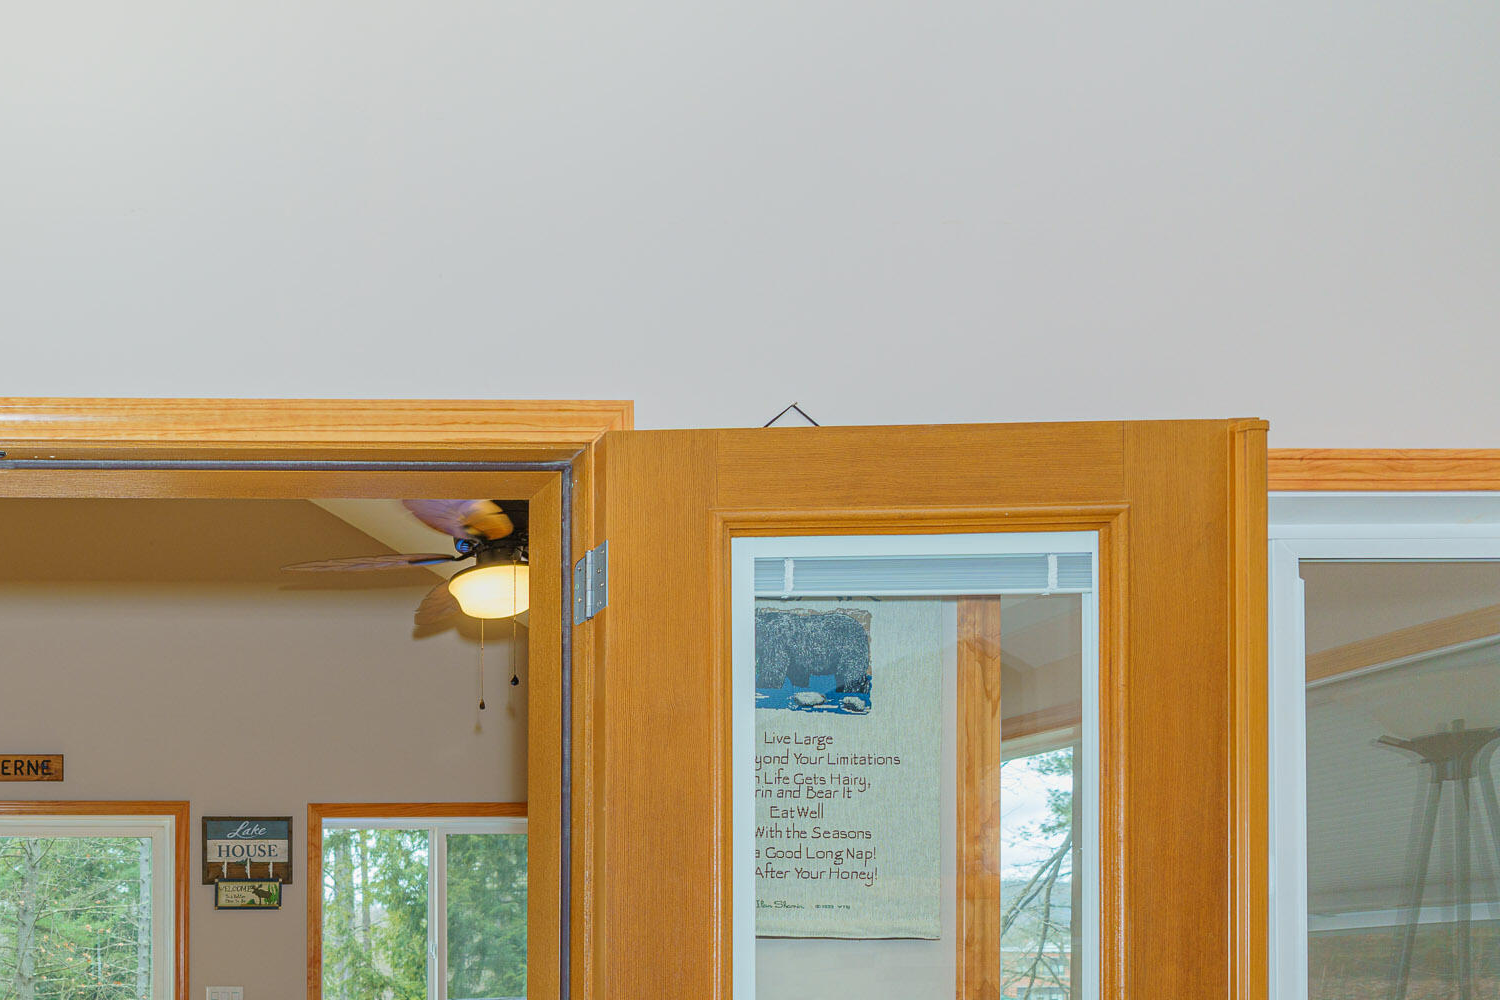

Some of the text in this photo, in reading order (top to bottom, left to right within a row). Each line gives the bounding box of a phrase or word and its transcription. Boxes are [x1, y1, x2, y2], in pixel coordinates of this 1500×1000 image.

[764, 731, 834, 751] Live Large
[755, 748, 901, 771] yond Your Limitations
[764, 767, 790, 785] Life
[793, 772, 827, 785] Gets
[830, 772, 871, 793] Hairy,
[755, 784, 853, 799] rin and Bear It
[769, 802, 824, 819] Eat Well
[226, 820, 268, 839] Lake
[755, 822, 872, 840] With the Seasons
[217, 844, 278, 858] HOUSE
[765, 843, 802, 859] Good
[806, 847, 844, 866] Long
[846, 846, 877, 868] Nap!
[755, 862, 878, 887] After Your Honey!
